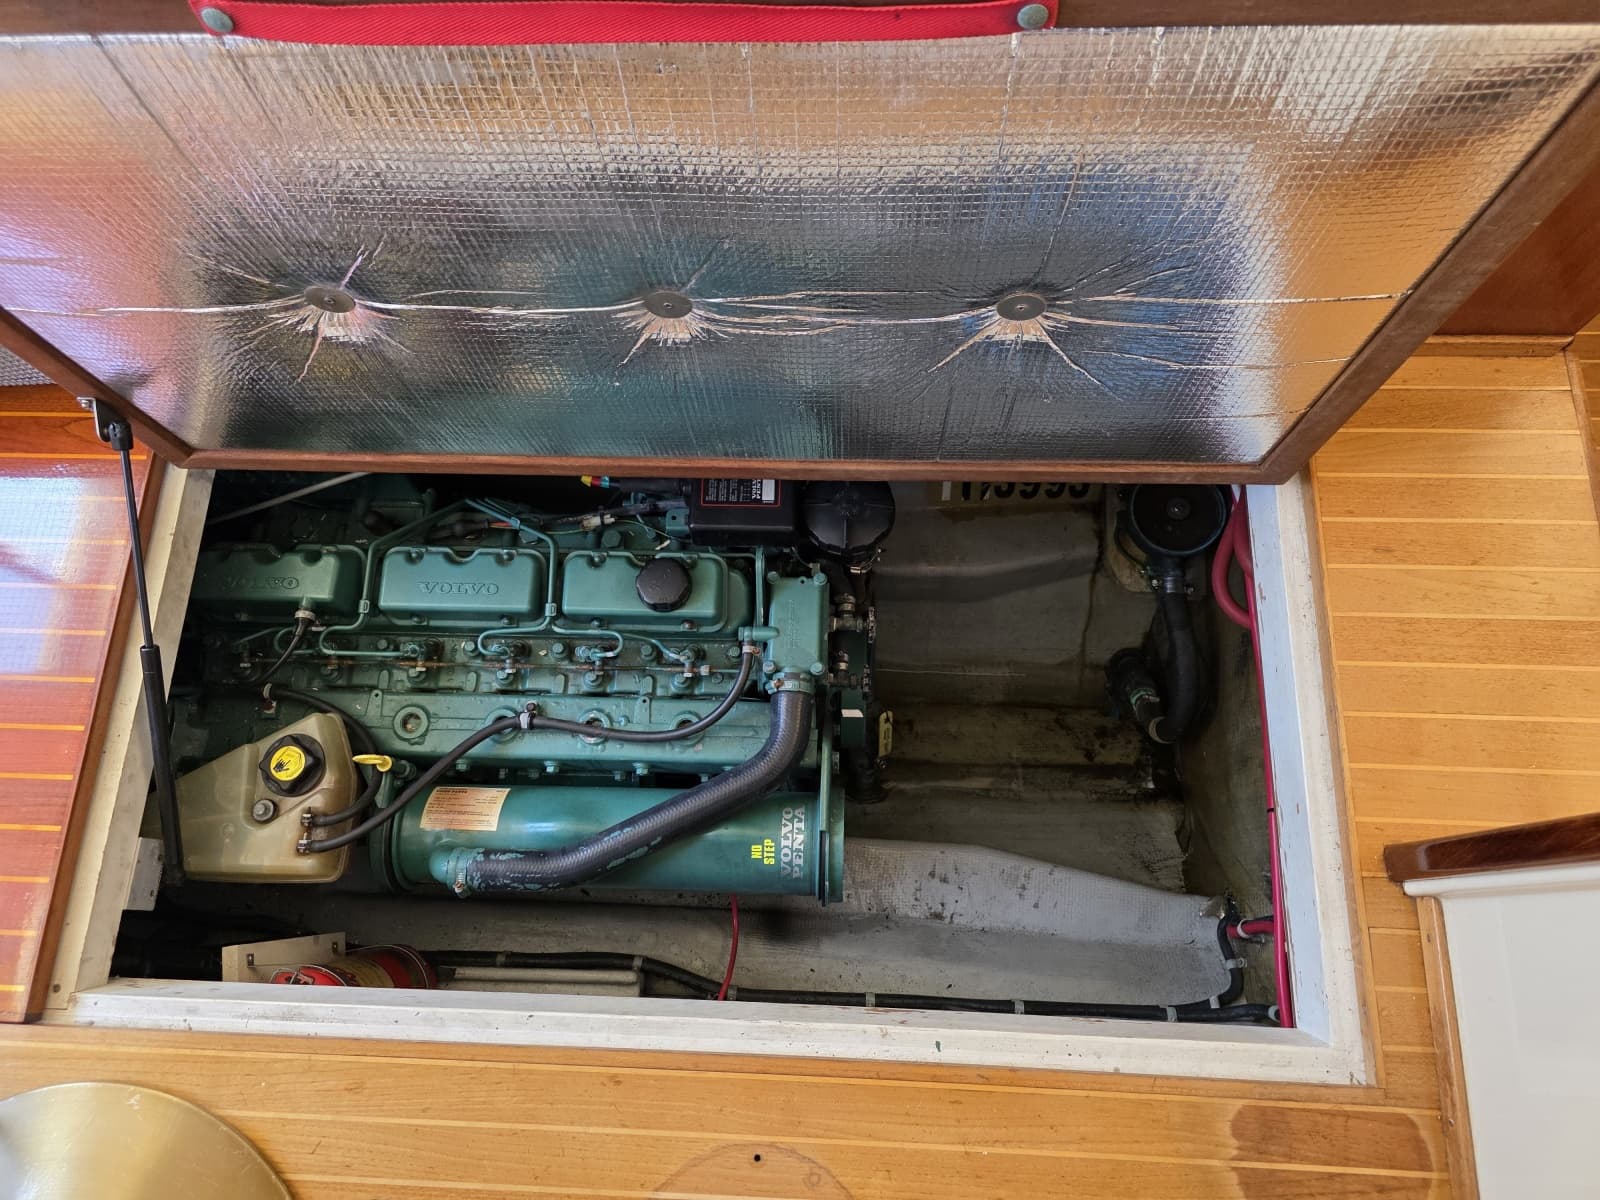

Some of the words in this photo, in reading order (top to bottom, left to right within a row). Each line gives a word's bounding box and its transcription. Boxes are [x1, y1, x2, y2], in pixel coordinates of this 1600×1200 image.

[417, 581, 500, 595] VOLVO
[751, 844, 762, 859] NO
[763, 839, 775, 865] STEP
[780, 807, 793, 876] VOLVO
[793, 806, 805, 879] PENTA
